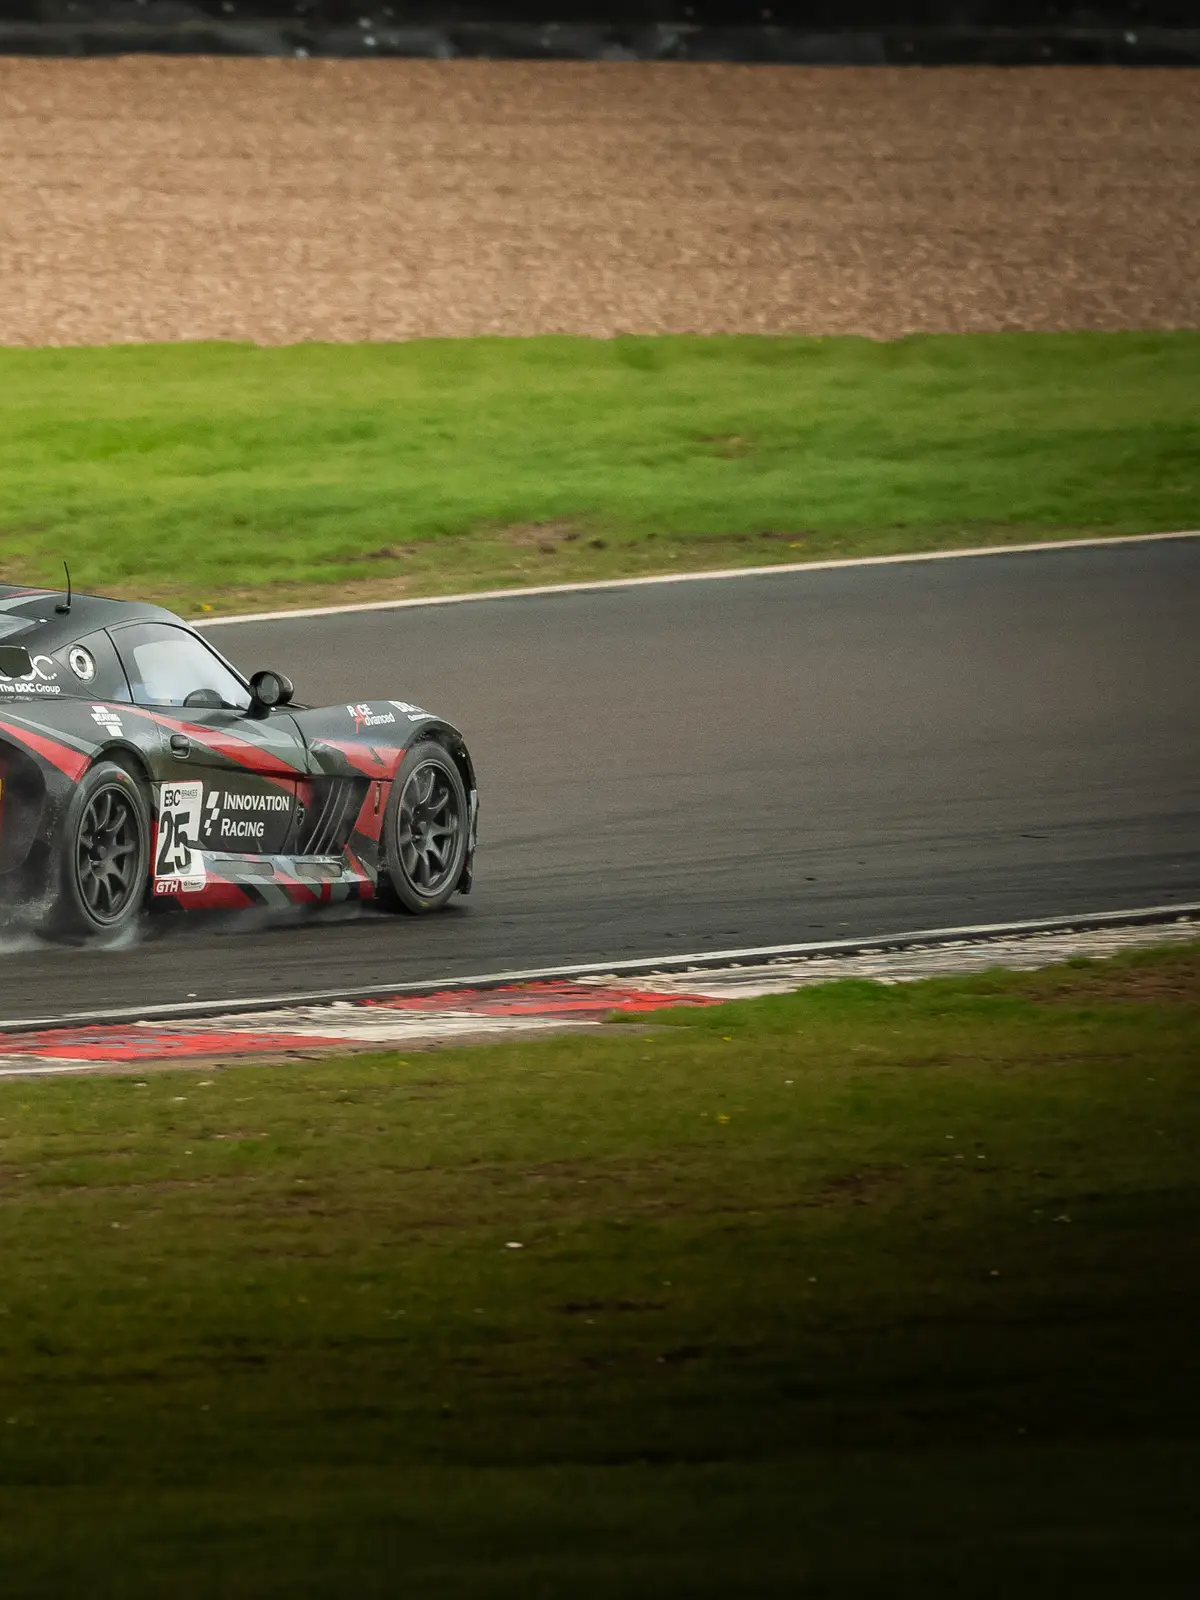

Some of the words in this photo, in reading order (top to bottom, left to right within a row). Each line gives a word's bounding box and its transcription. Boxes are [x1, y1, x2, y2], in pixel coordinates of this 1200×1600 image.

[15, 683, 35, 693] DDC
[35, 683, 61, 695] Group
[223, 791, 290, 811] INNOVATION
[220, 818, 265, 837] RACING
[156, 810, 192, 876] 25
[156, 880, 179, 894] GTH
